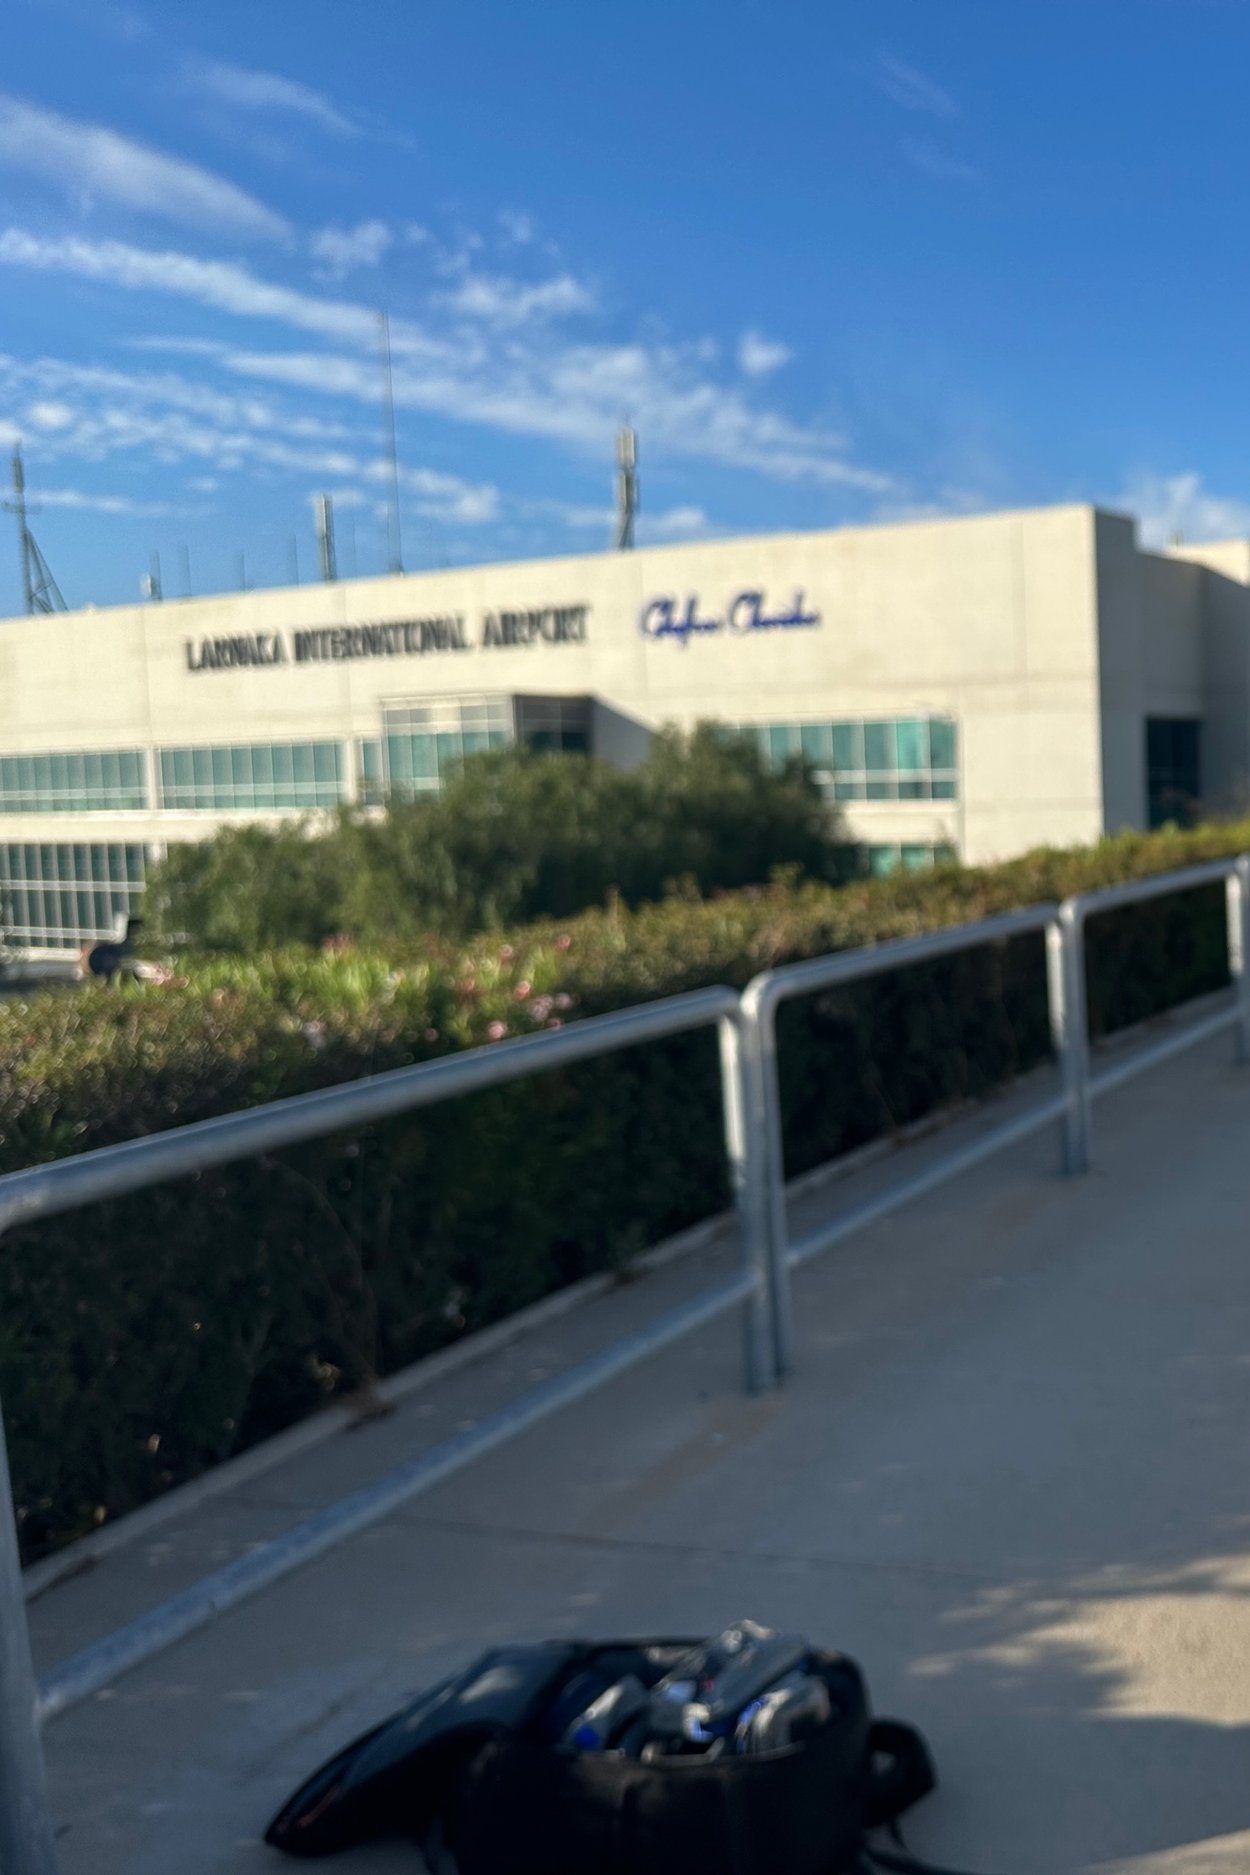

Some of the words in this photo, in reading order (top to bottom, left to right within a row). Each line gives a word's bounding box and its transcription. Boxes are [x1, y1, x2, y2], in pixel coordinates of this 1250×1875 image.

[186, 634, 287, 671] LARNAKA
[293, 615, 470, 661] INTERNATIONAL
[481, 603, 590, 647] AIRPORT
